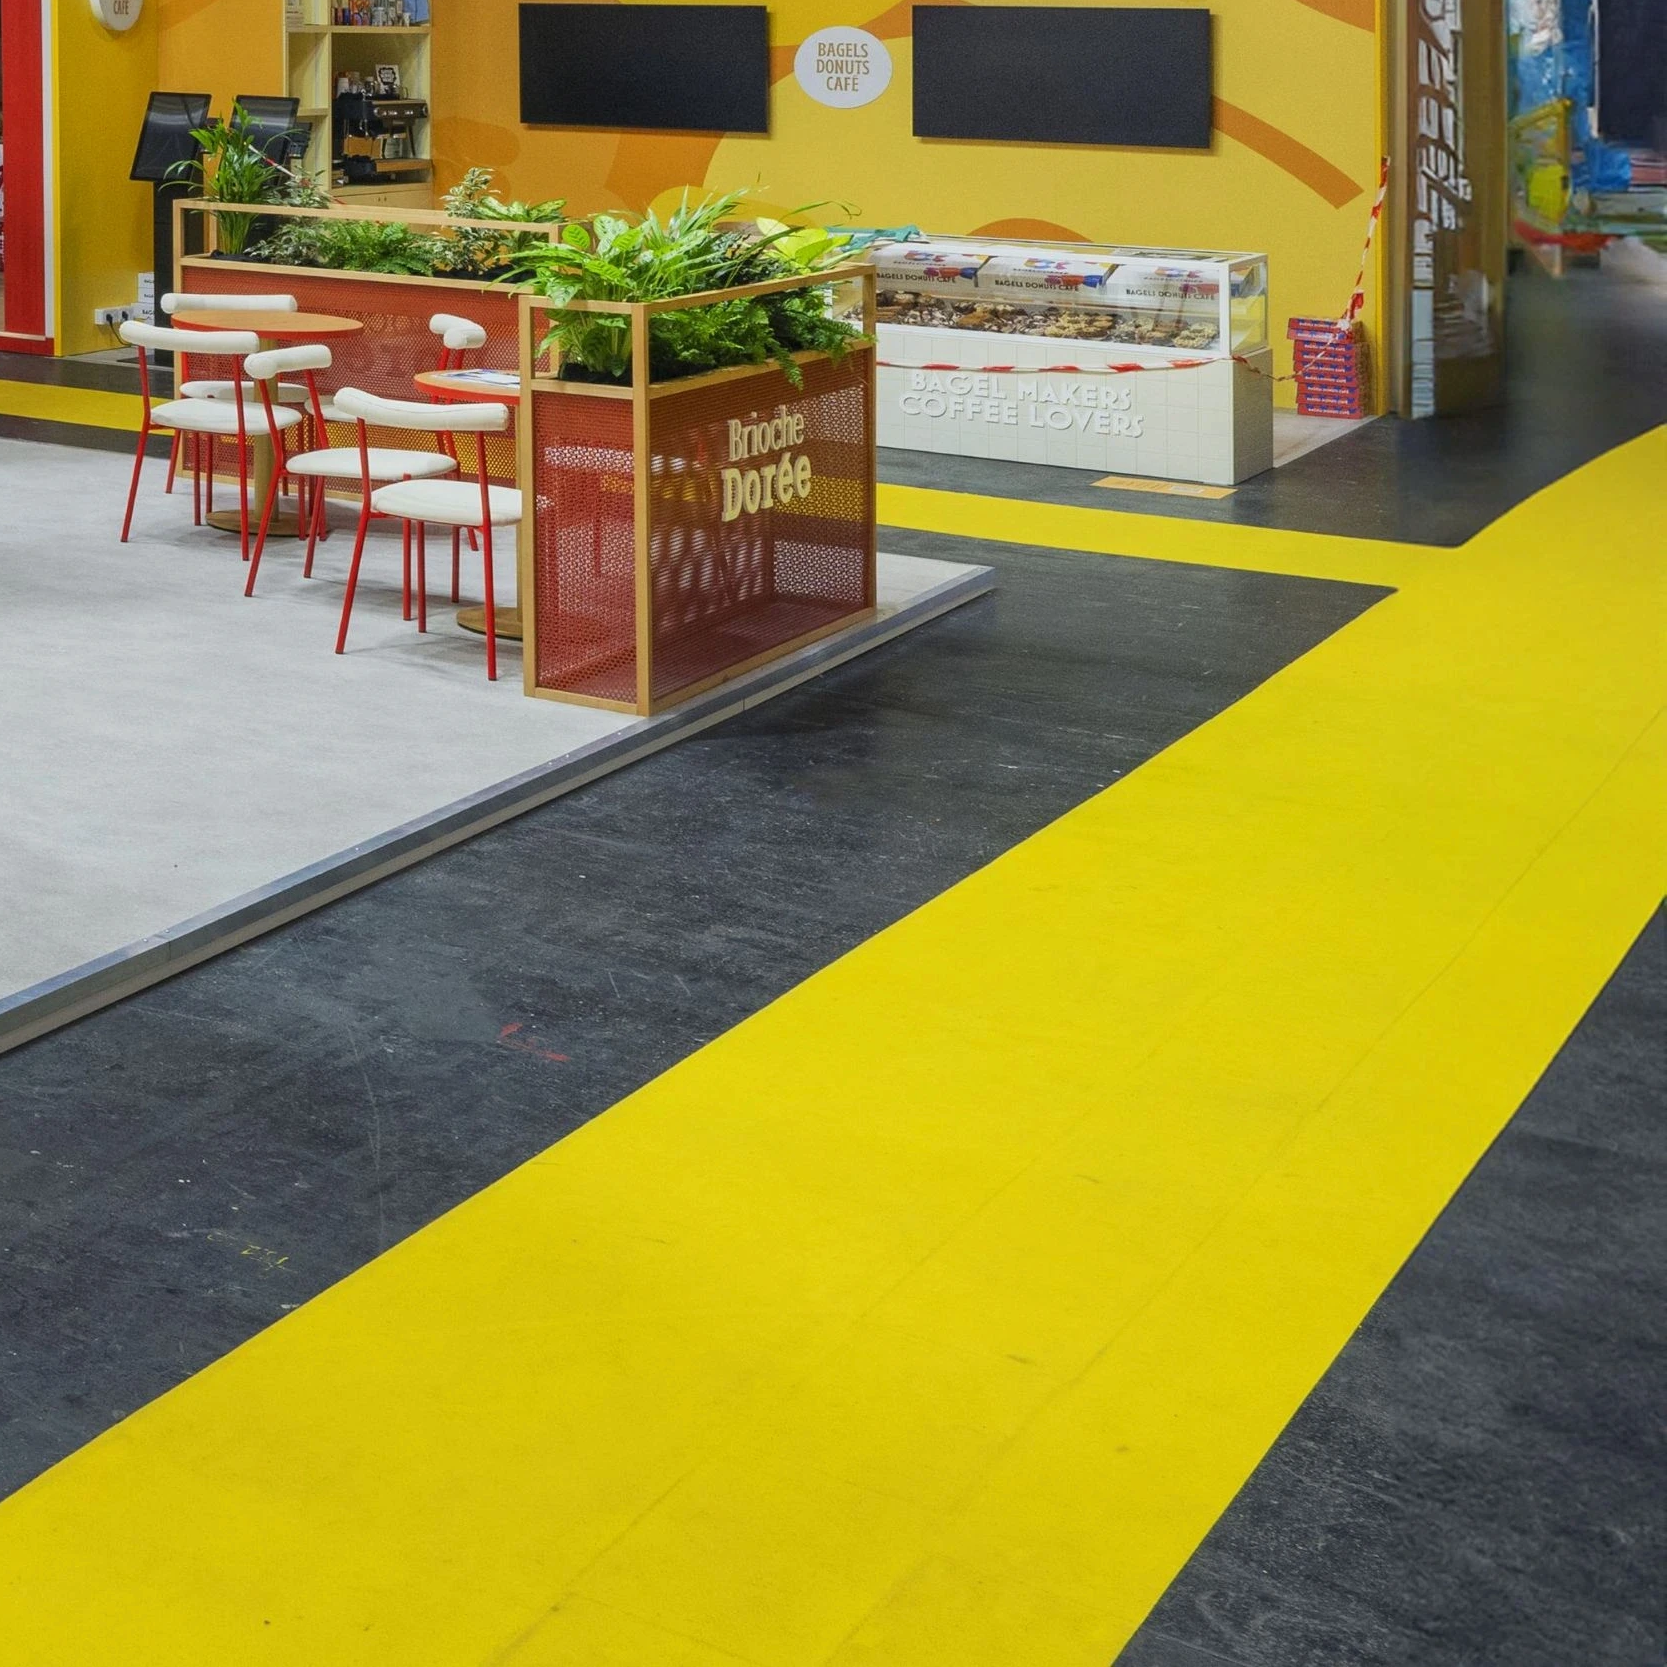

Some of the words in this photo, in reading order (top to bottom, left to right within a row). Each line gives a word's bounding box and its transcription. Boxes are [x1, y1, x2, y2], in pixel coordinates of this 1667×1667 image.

[816, 59, 870, 75] DONUTS
[818, 42, 869, 58] BAGELS
[1126, 288, 1156, 297] BAGELS
[911, 371, 1008, 400] BAGEL
[1018, 379, 1133, 412] MAKERS
[727, 404, 805, 462] Brioche
[898, 391, 1019, 426] COFFEE
[1029, 403, 1146, 438] LOVERS
[721, 452, 812, 522] Dorée
